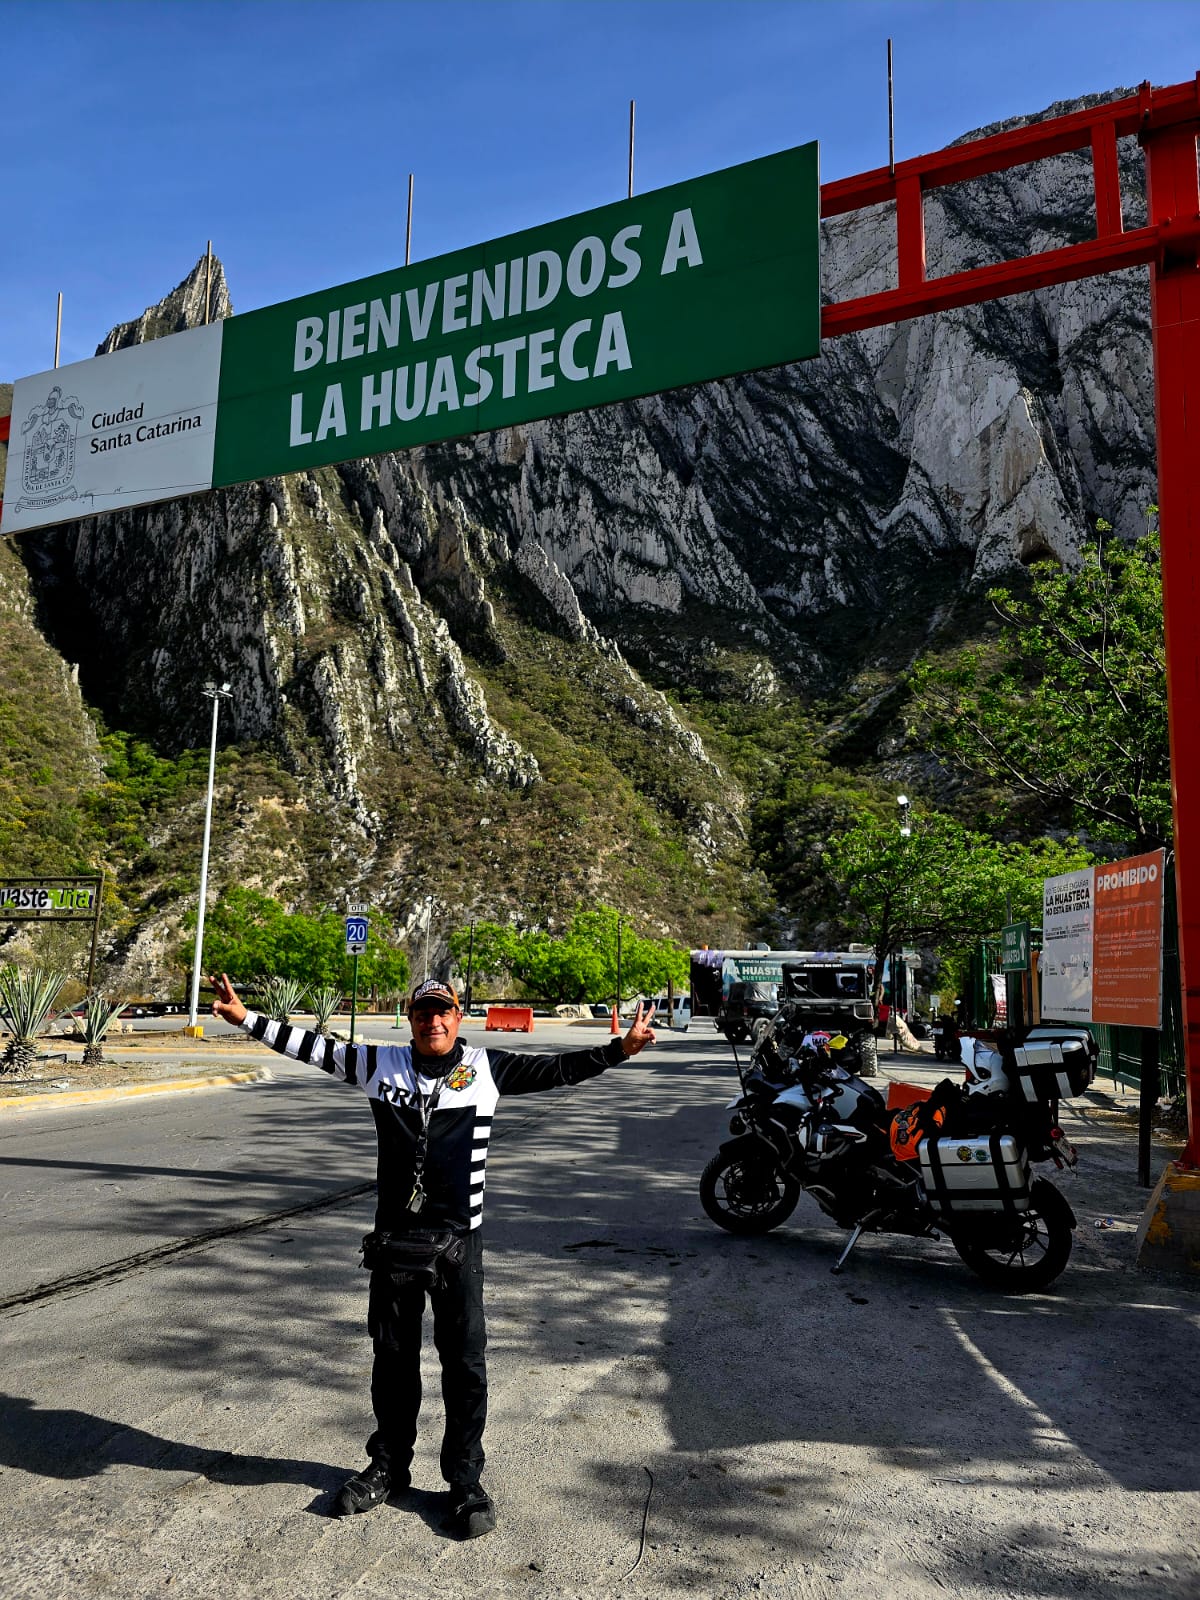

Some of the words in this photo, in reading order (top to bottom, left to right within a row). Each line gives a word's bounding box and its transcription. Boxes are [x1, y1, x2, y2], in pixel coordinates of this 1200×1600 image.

[293, 225, 642, 372] BIENVENIDOS
[660, 208, 703, 275] A
[289, 383, 347, 447] LA
[360, 311, 632, 431] HUASTECA
[92, 402, 144, 429] Ciudad
[90, 433, 131, 454] Santa
[136, 415, 201, 442] Catarina
[1097, 864, 1157, 891] PROHIBIDO
[1045, 907, 1052, 916] NO
[1065, 904, 1072, 912] EN
[1073, 901, 1089, 911] VENTA
[1046, 895, 1054, 906] LA
[1055, 888, 1089, 905] HUASTECA
[349, 924, 365, 941] 20
[742, 966, 783, 976] HUASTE
